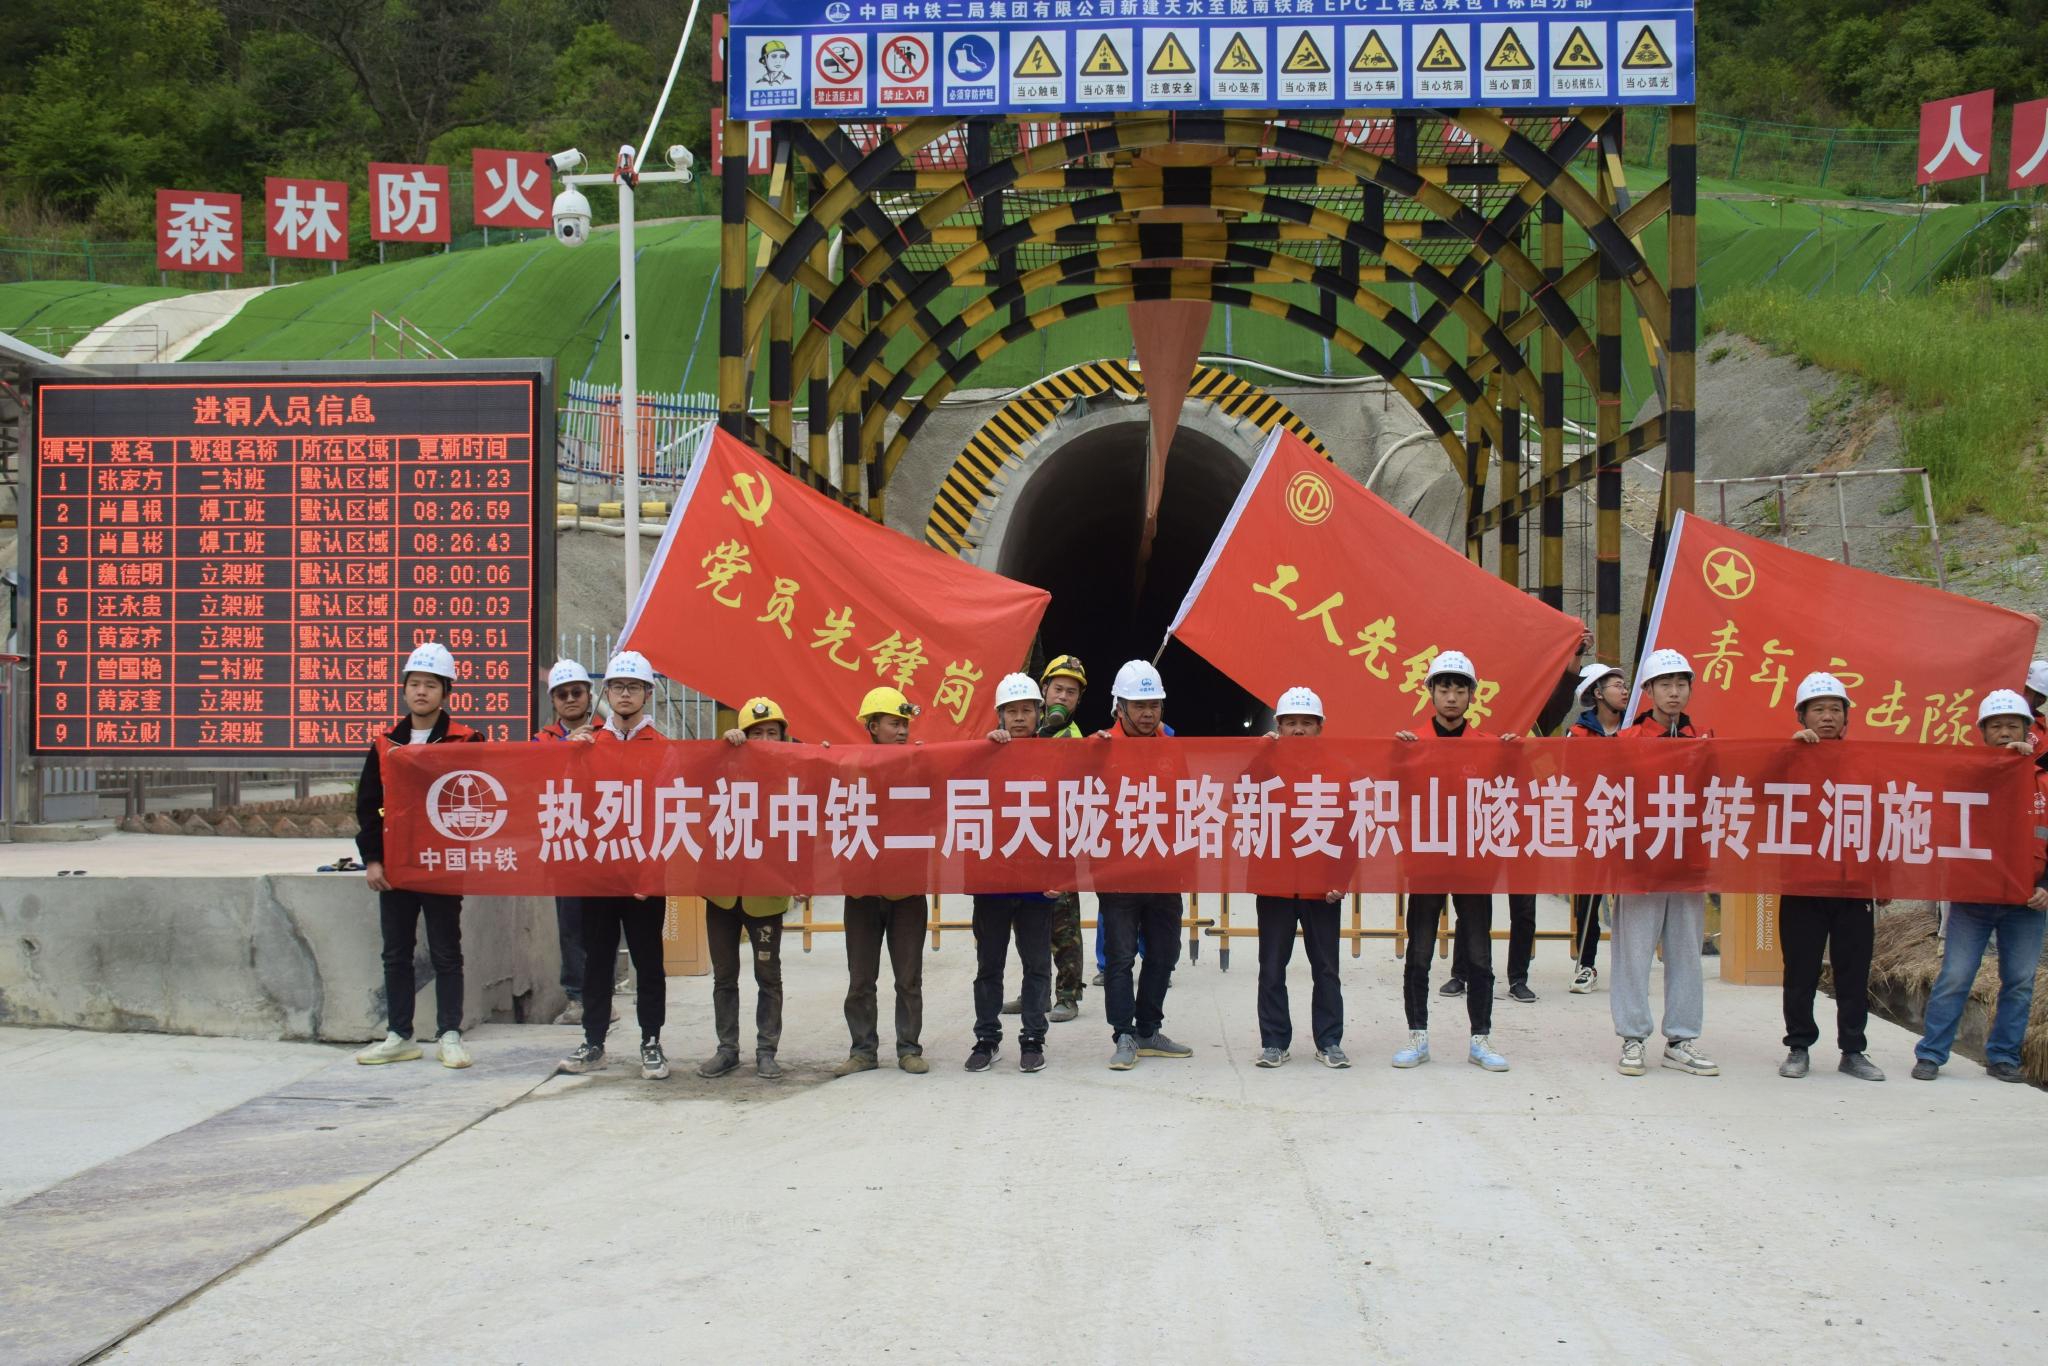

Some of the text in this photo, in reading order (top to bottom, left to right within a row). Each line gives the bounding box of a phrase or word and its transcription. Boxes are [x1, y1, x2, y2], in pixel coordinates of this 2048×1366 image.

[949, 88, 993, 101] 必须穿防护鞋
[1017, 86, 1059, 98] 当心触电
[1083, 84, 1126, 96] 当心落物
[1150, 83, 1193, 94] 注意安全
[1218, 82, 1260, 93] 当心坠落
[1285, 81, 1328, 93] 当心滑跌
[1352, 80, 1396, 91] 当心车辆
[1421, 79, 1464, 91] 当心坑洞
[1489, 79, 1532, 90] 当心冒顶
[1556, 78, 1602, 90] 当心机械伤人
[1626, 77, 1670, 89] 当心弧光
[818, 91, 859, 102] 禁止酒后上岗
[884, 90, 925, 101] 禁止入内
[166, 158, 543, 265] 森林防火
[193, 395, 375, 426] 进洞人员信息
[43, 438, 508, 462] 编号 姓名 班组名称 所在区域 更新时间
[58, 467, 510, 491] 1 张家方 二衬班 默认区域 07:21:23
[57, 504, 68, 523] 2
[300, 498, 389, 522] 默认区域
[414, 500, 510, 521] 08:26:59
[57, 535, 68, 554] 3
[300, 530, 389, 553] 默认区域
[414, 531, 510, 552] 08:26:43
[57, 561, 510, 586] 4 魏德明 立架班 默认区域 08:00:06
[57, 593, 510, 617] 5 汪永贵 立架班 默认区域 08:00:03
[57, 630, 67, 649] 6
[97, 626, 162, 649] 黄家齐
[200, 626, 264, 648] 立架班
[300, 625, 388, 648] 默认区域
[696, 538, 983, 725] 党员先锋岗
[57, 662, 67, 681] 7
[200, 657, 264, 680] 二衬班
[299, 656, 388, 680] 默认区域
[57, 693, 67, 712] 8
[97, 689, 161, 712] 黄家奎
[200, 689, 263, 712] 立架班
[299, 688, 387, 711] 默认区域
[57, 725, 67, 744] 9
[96, 721, 161, 744] 陈立财
[200, 720, 263, 743] 立架班
[537, 774, 1993, 865] 热烈庆祝中铁二局天陇铁路新麦积山隧道斜井转正洞施工
[419, 846, 518, 872] 中国中铁
[671, 901, 679, 942] PARKING
[1764, 910, 1774, 951] PARKING
